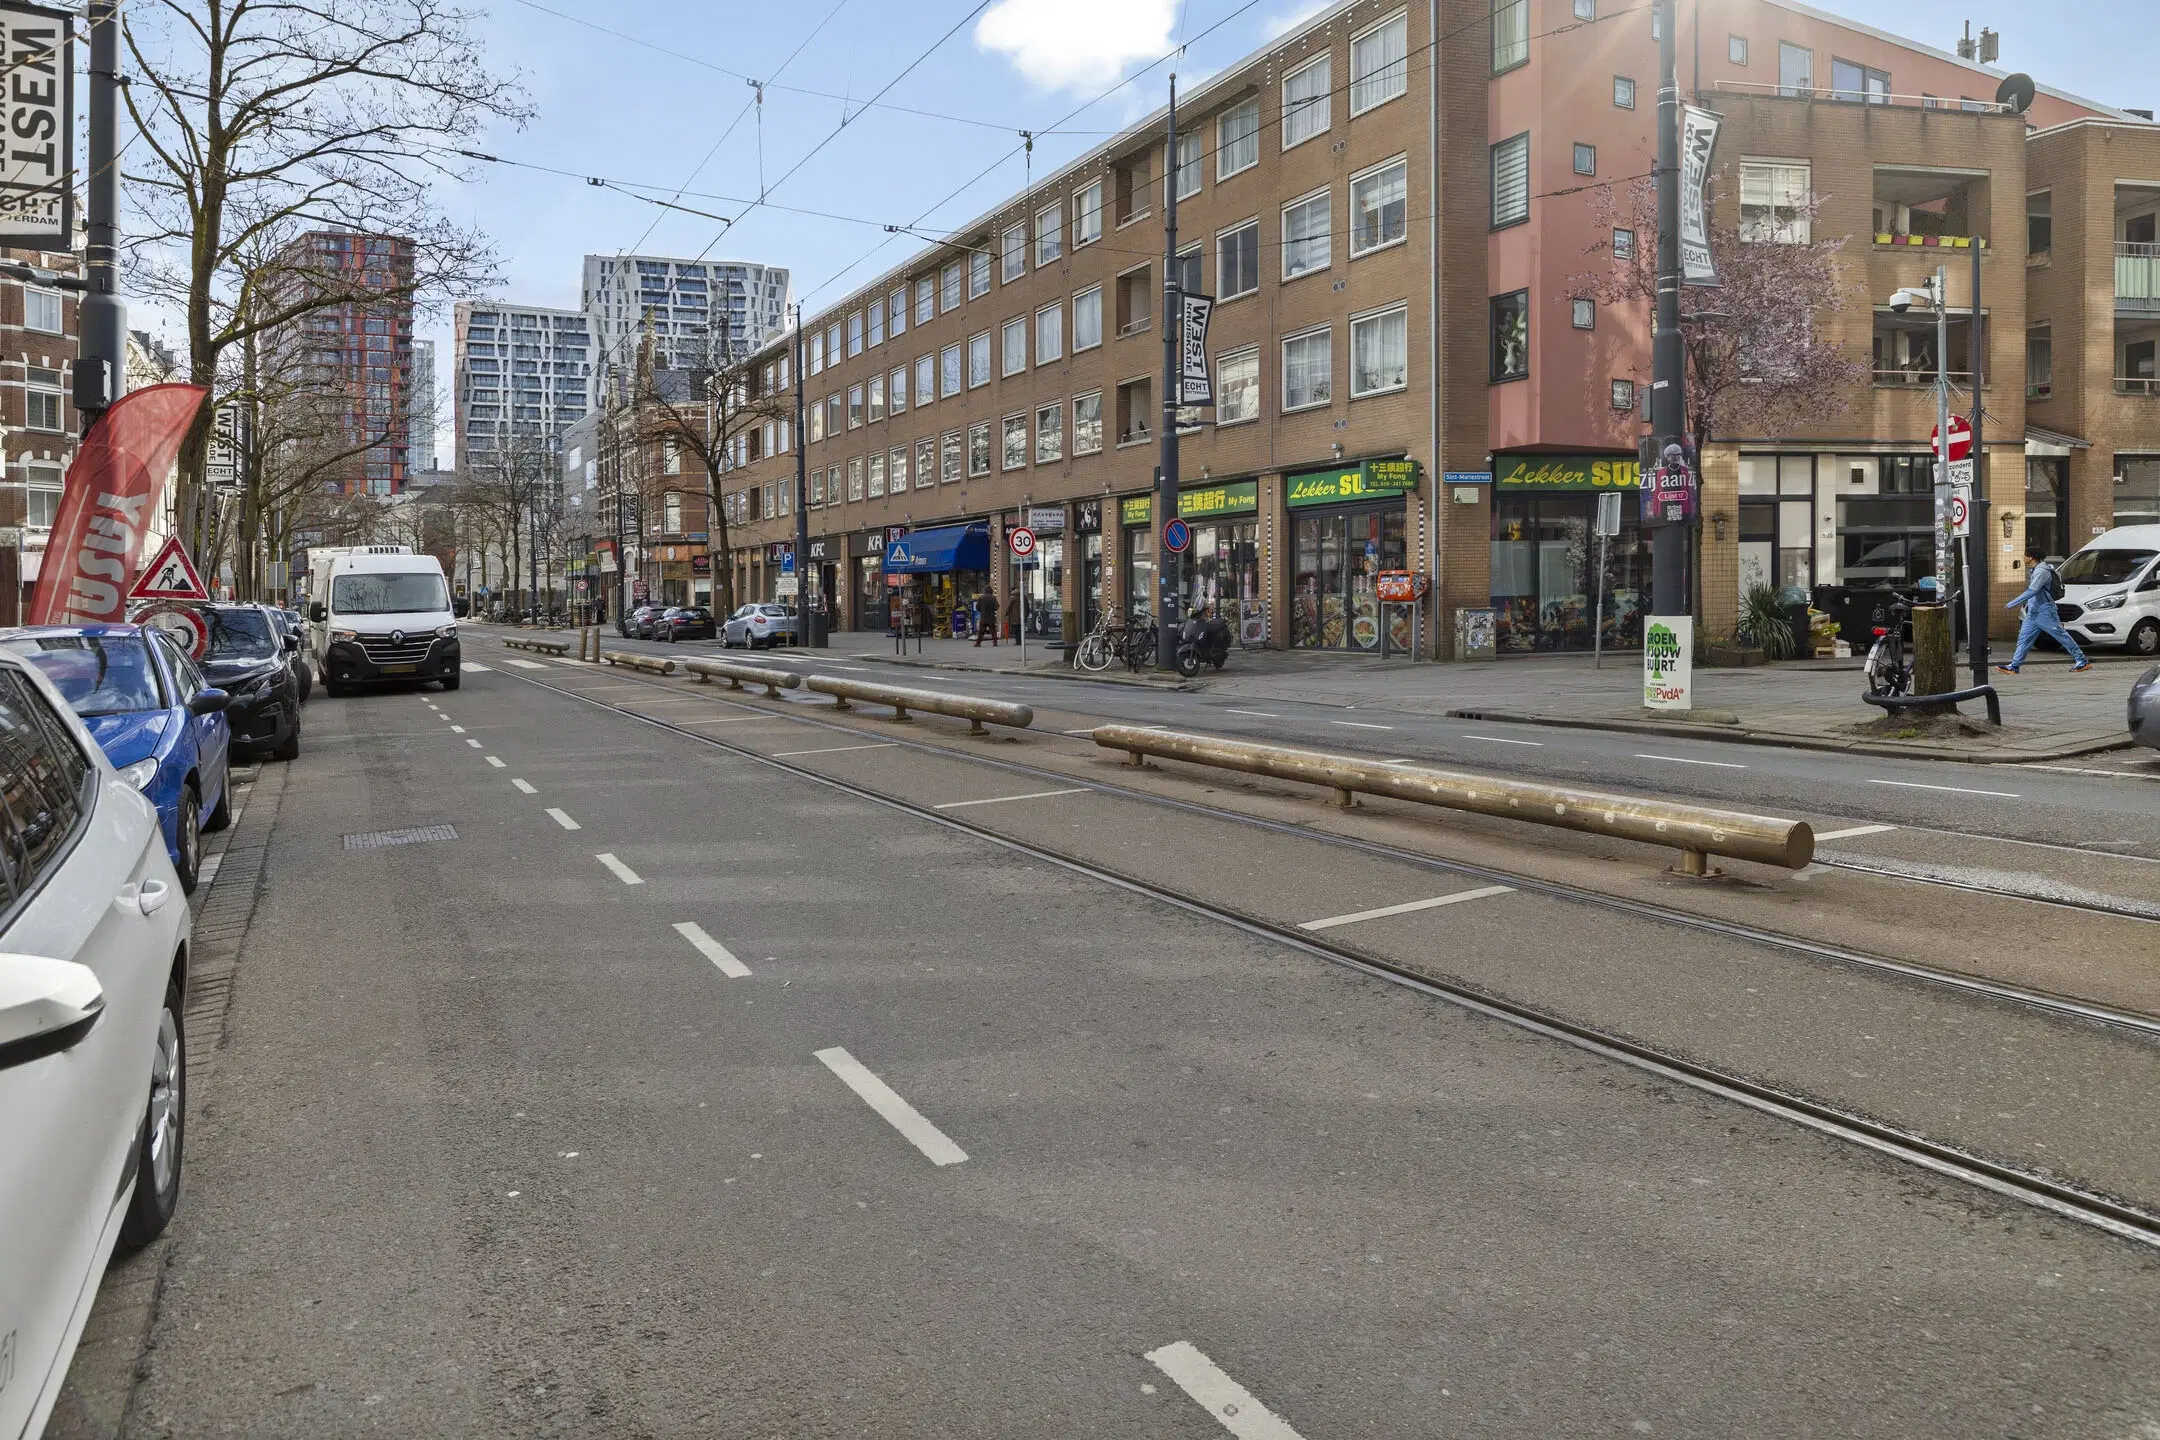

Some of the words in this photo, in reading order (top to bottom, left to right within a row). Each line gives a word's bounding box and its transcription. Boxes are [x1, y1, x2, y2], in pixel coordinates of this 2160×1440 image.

[1691, 128, 1712, 237] WEST
[0, 194, 60, 216] CHT
[1684, 248, 1709, 265] ECHT
[1192, 305, 1207, 373] WEST
[1185, 382, 1207, 391] ECHT
[207, 467, 232, 475] ECHT
[1377, 473, 1387, 481] My
[1389, 472, 1407, 481] Fong
[1502, 462, 1586, 484] Lekker
[1290, 480, 1336, 498] Lekker
[1640, 472, 1656, 492] Zij
[1660, 473, 1687, 488] aan
[1228, 496, 1239, 507] My
[1239, 495, 1255, 506] Fong
[810, 542, 825, 557] KFC
[1015, 536, 1031, 547] 30
[1656, 687, 1680, 700] PvdA
